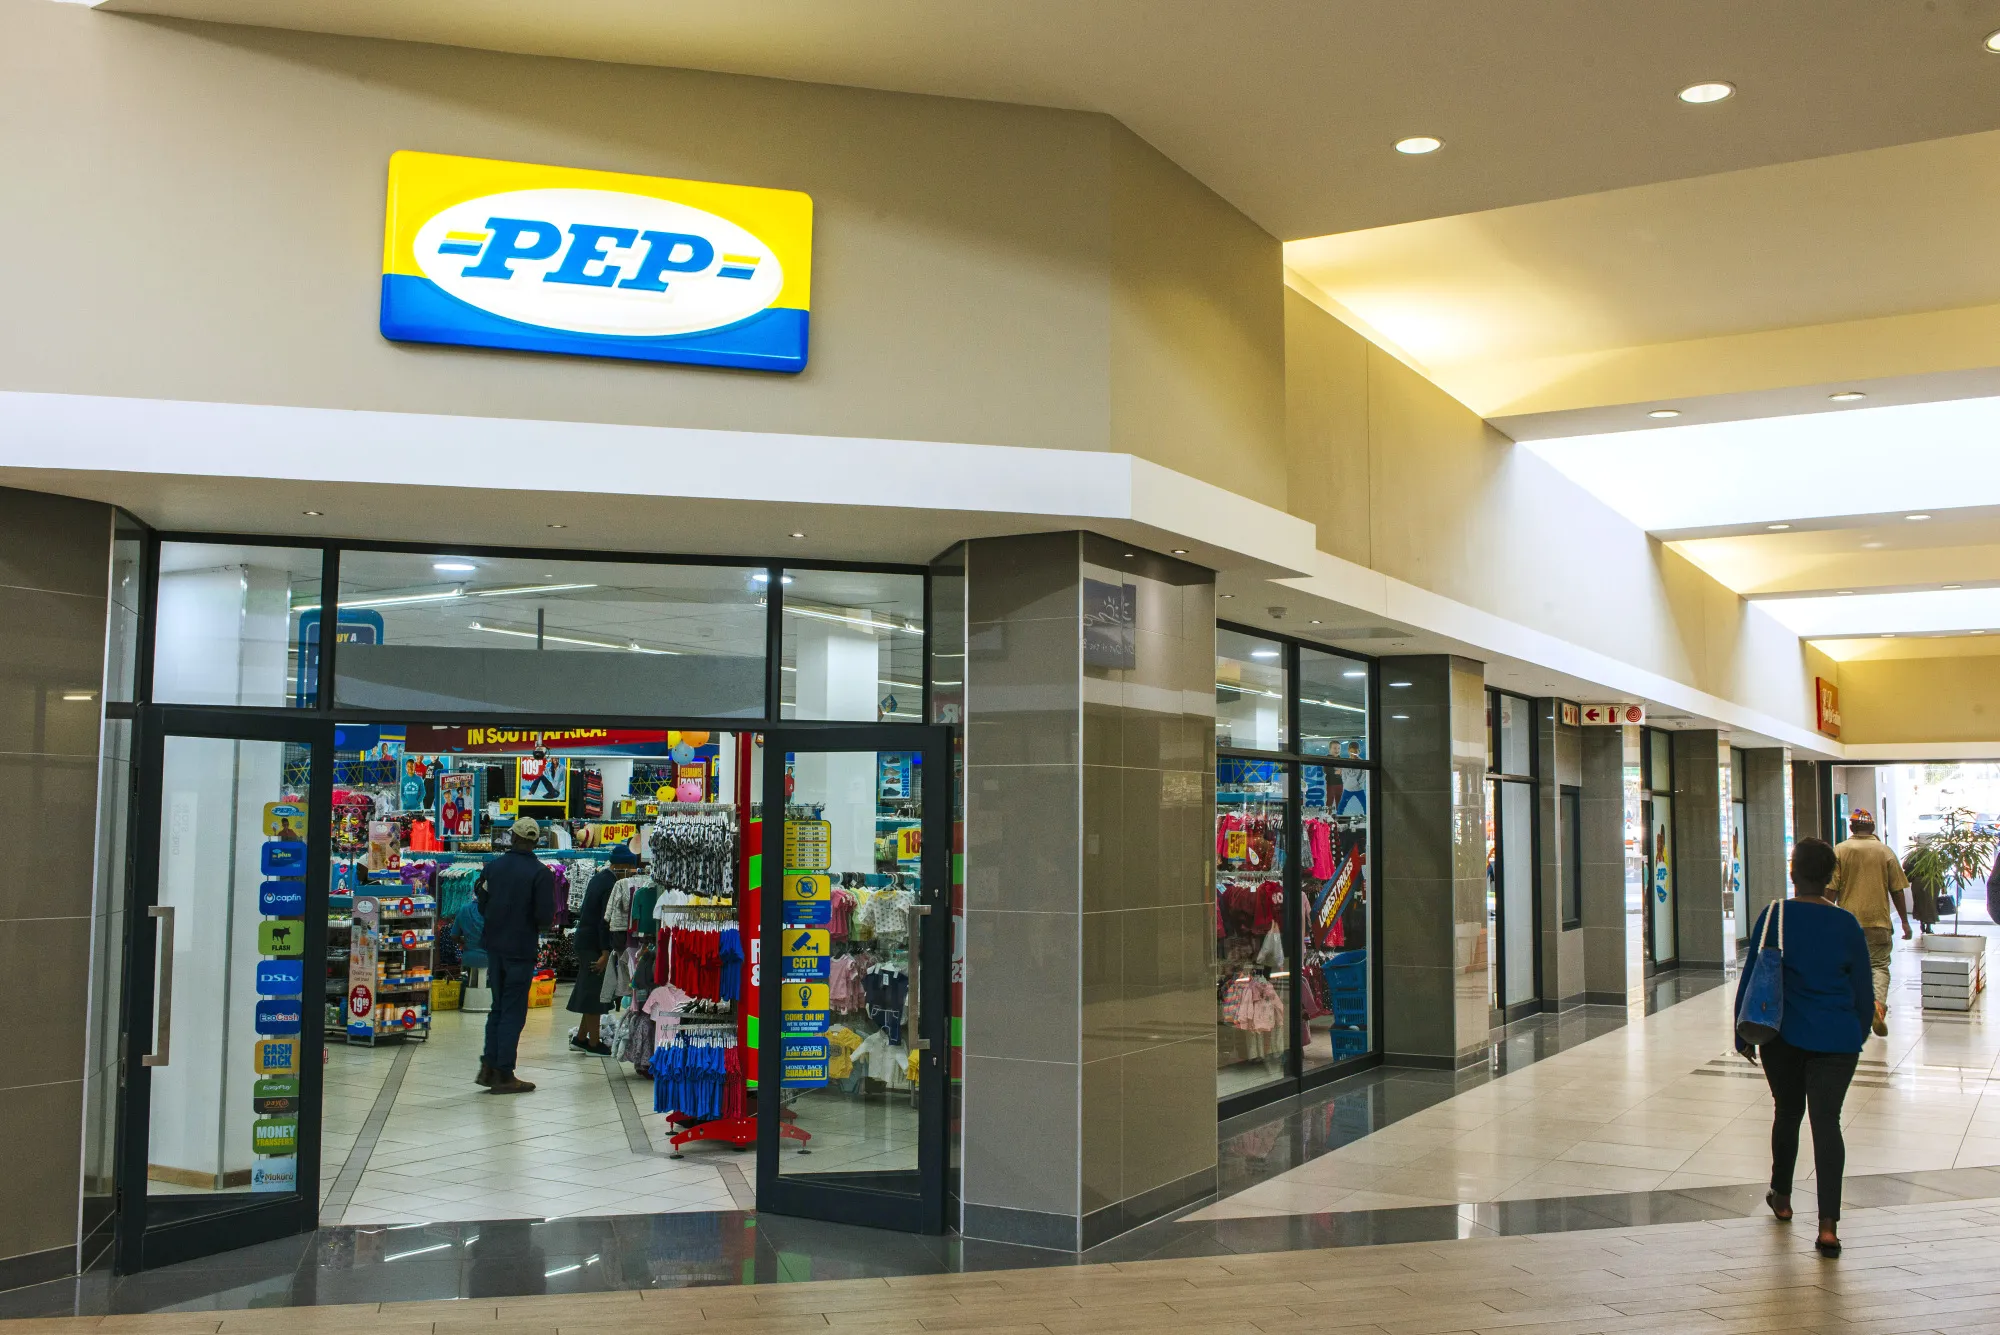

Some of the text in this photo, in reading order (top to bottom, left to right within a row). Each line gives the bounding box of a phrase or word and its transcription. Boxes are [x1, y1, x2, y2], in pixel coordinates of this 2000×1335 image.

[460, 217, 714, 293] PEP
[467, 728, 484, 745] IN
[901, 767, 910, 798] SHOES
[276, 893, 302, 902] capfin
[792, 957, 818, 969] CCTV
[260, 973, 300, 982] DStv
[260, 1012, 300, 1022] EcoCash
[784, 1013, 804, 1021] COME
[804, 1013, 815, 1021] ON
[263, 1043, 292, 1055] CASH
[263, 1055, 292, 1066] BACK
[785, 1069, 823, 1077] GUARANTEE
[256, 1124, 296, 1139] MONEY
[256, 1138, 295, 1147] TRANSFERS
